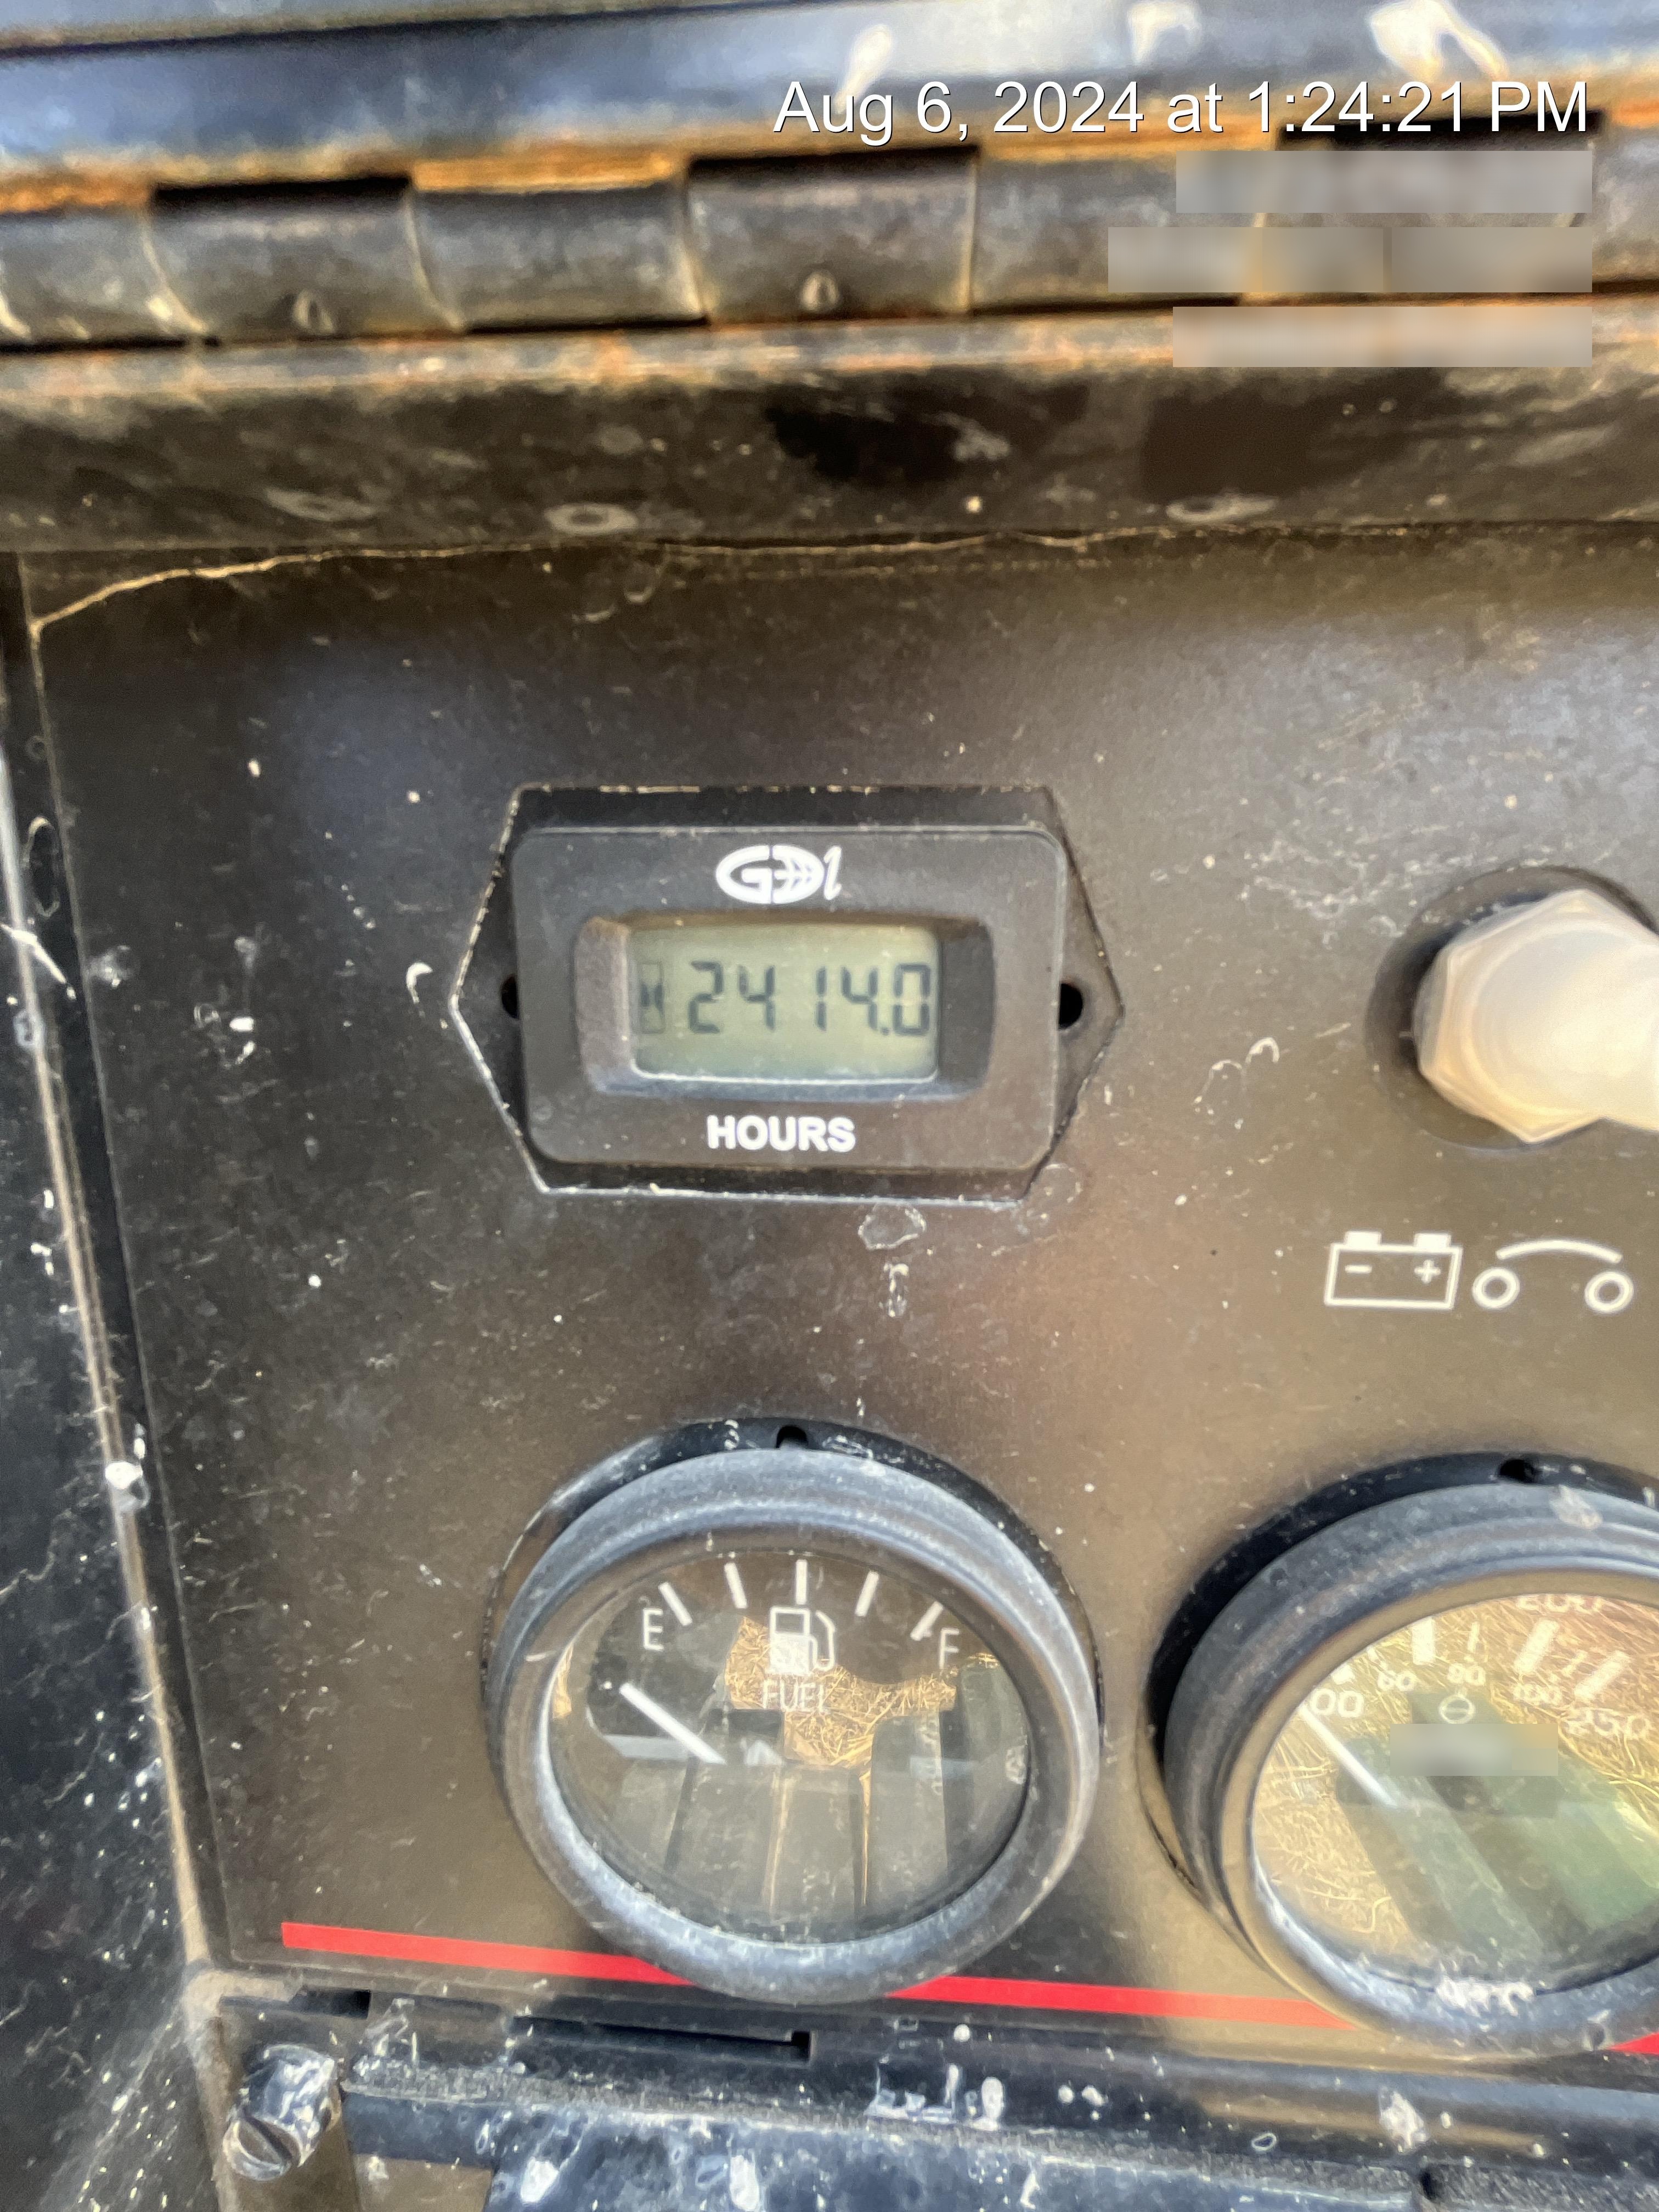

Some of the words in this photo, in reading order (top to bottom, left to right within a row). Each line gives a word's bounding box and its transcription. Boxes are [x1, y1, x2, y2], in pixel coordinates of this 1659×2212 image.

[689, 960, 932, 1037] 2414.0
[706, 1114, 857, 1154] HOURS
[642, 1607, 664, 1650] E
[938, 1628, 960, 1669] F
